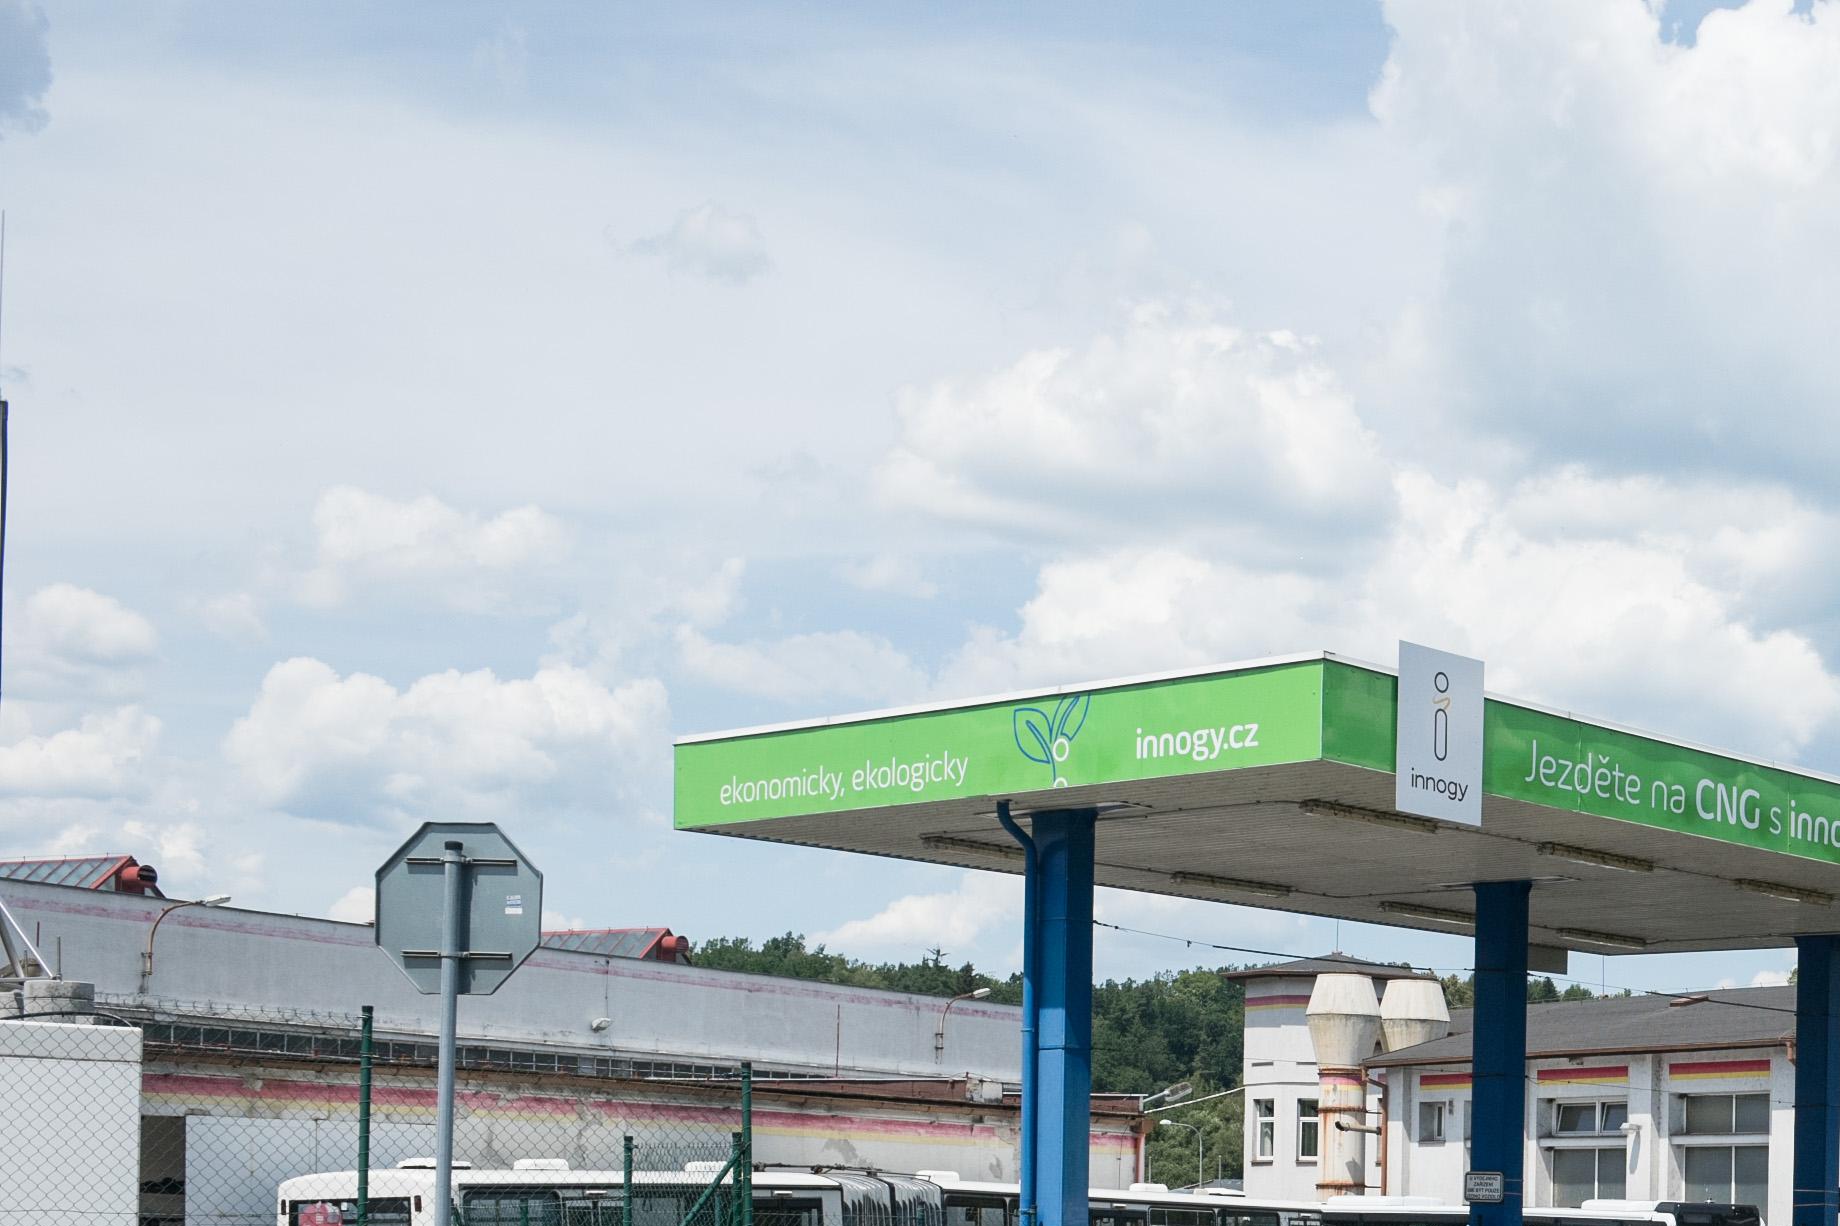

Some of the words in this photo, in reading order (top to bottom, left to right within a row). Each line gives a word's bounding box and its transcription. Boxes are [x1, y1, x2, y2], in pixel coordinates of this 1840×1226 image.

[1136, 723, 1260, 761] innogy.cz
[720, 765, 846, 805] ekonomicky,
[852, 750, 969, 792] ekologicky
[1411, 767, 1469, 802] innogy
[1524, 739, 1642, 805] Jezděte
[1650, 779, 1686, 814] na
[1695, 778, 1761, 830] CNG
[1769, 805, 1782, 836] s
